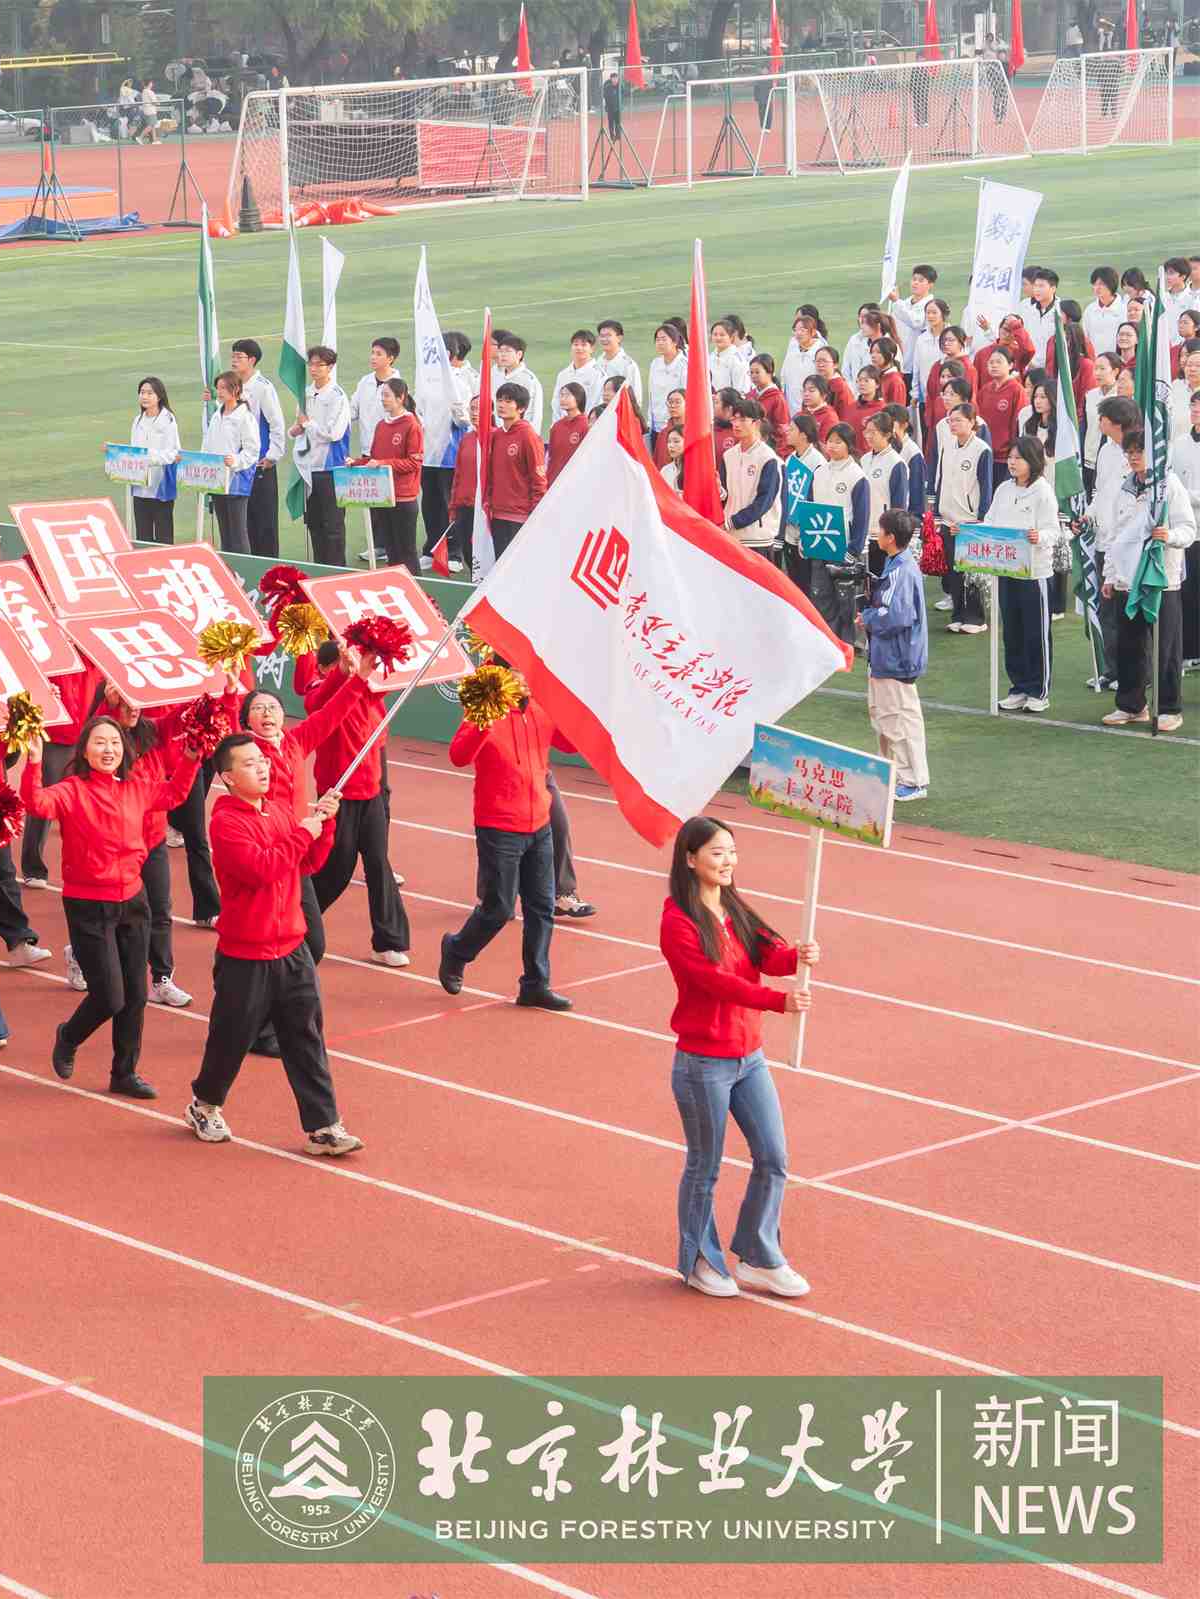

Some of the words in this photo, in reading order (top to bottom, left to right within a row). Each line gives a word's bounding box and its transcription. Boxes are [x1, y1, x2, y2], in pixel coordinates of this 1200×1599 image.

[787, 468, 806, 516] 科
[804, 512, 841, 553] 兴
[32, 515, 129, 603] 国
[89, 620, 216, 689] 思
[793, 758, 847, 789] 马克思
[784, 776, 856, 816] 主义学院
